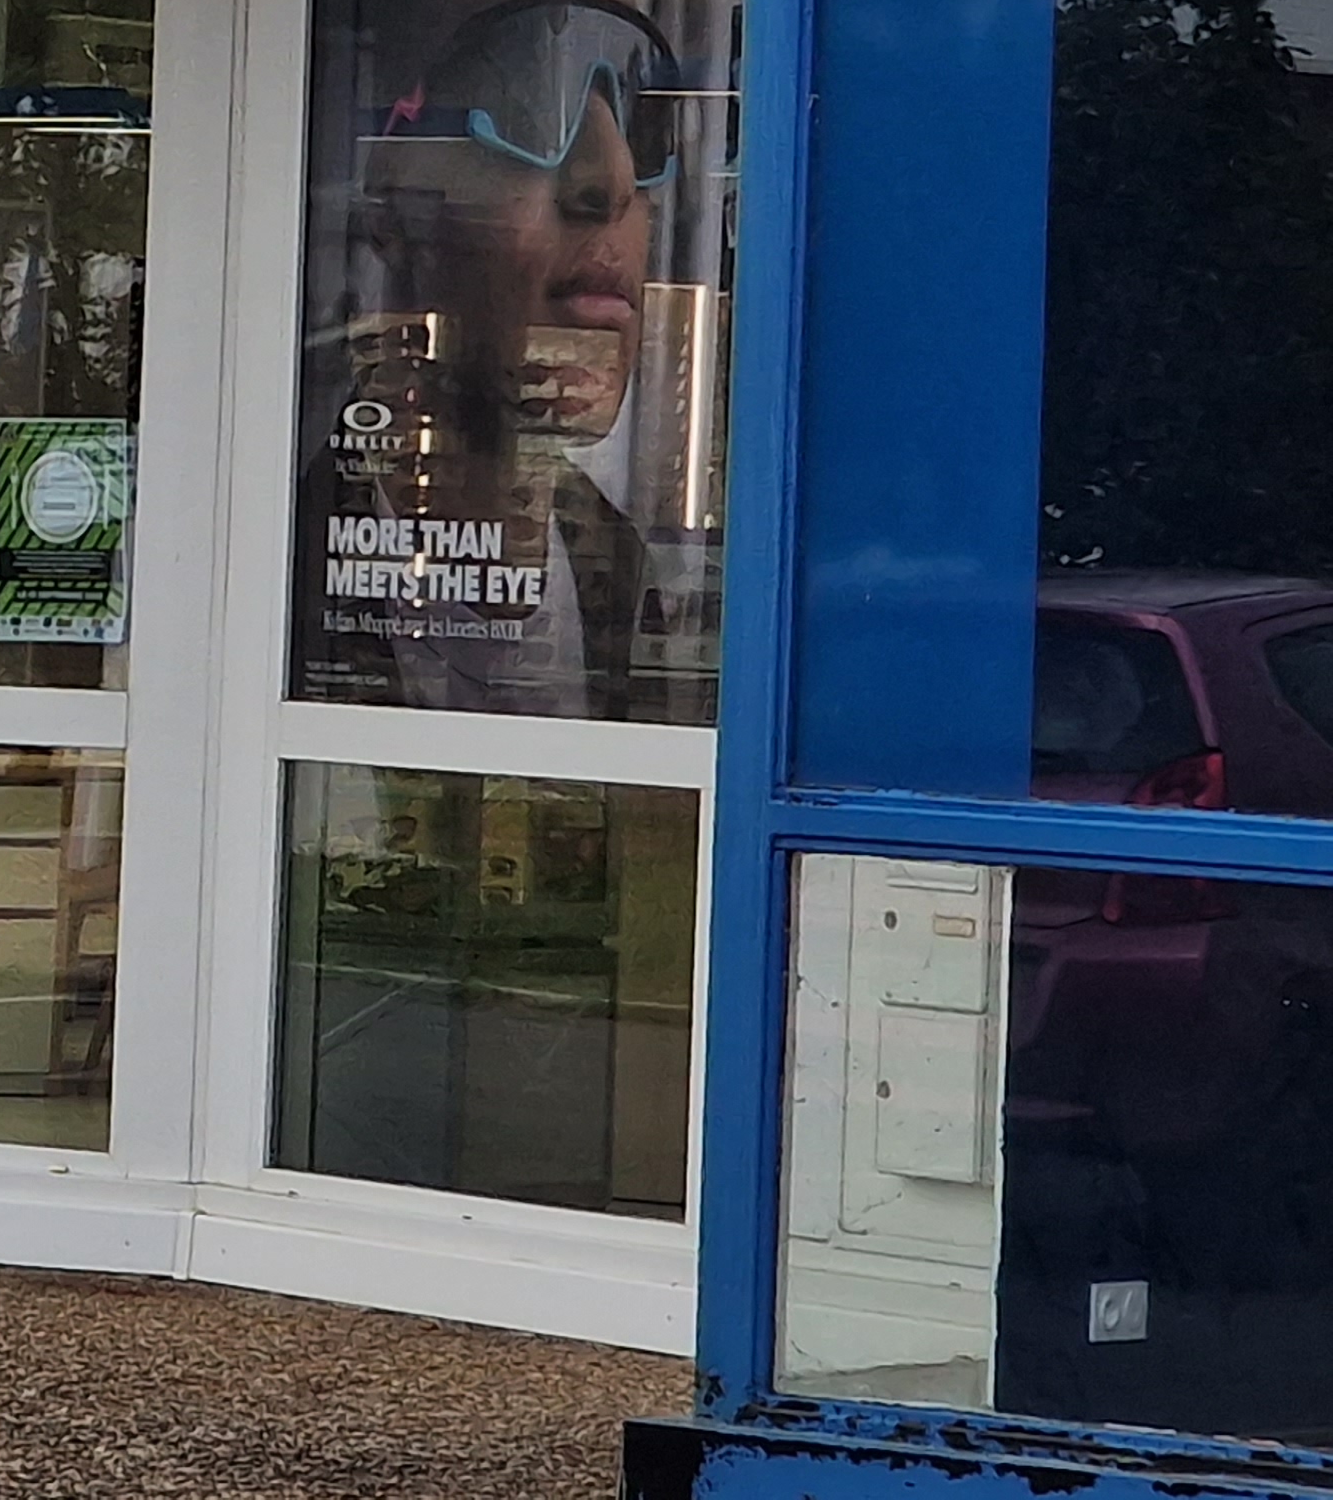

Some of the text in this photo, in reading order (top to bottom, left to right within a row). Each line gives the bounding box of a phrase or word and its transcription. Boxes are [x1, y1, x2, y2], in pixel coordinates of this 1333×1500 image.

[329, 434, 404, 450] OAKLEY
[327, 516, 504, 560] MORE THAN
[325, 558, 543, 606] MEETS THE EYE
